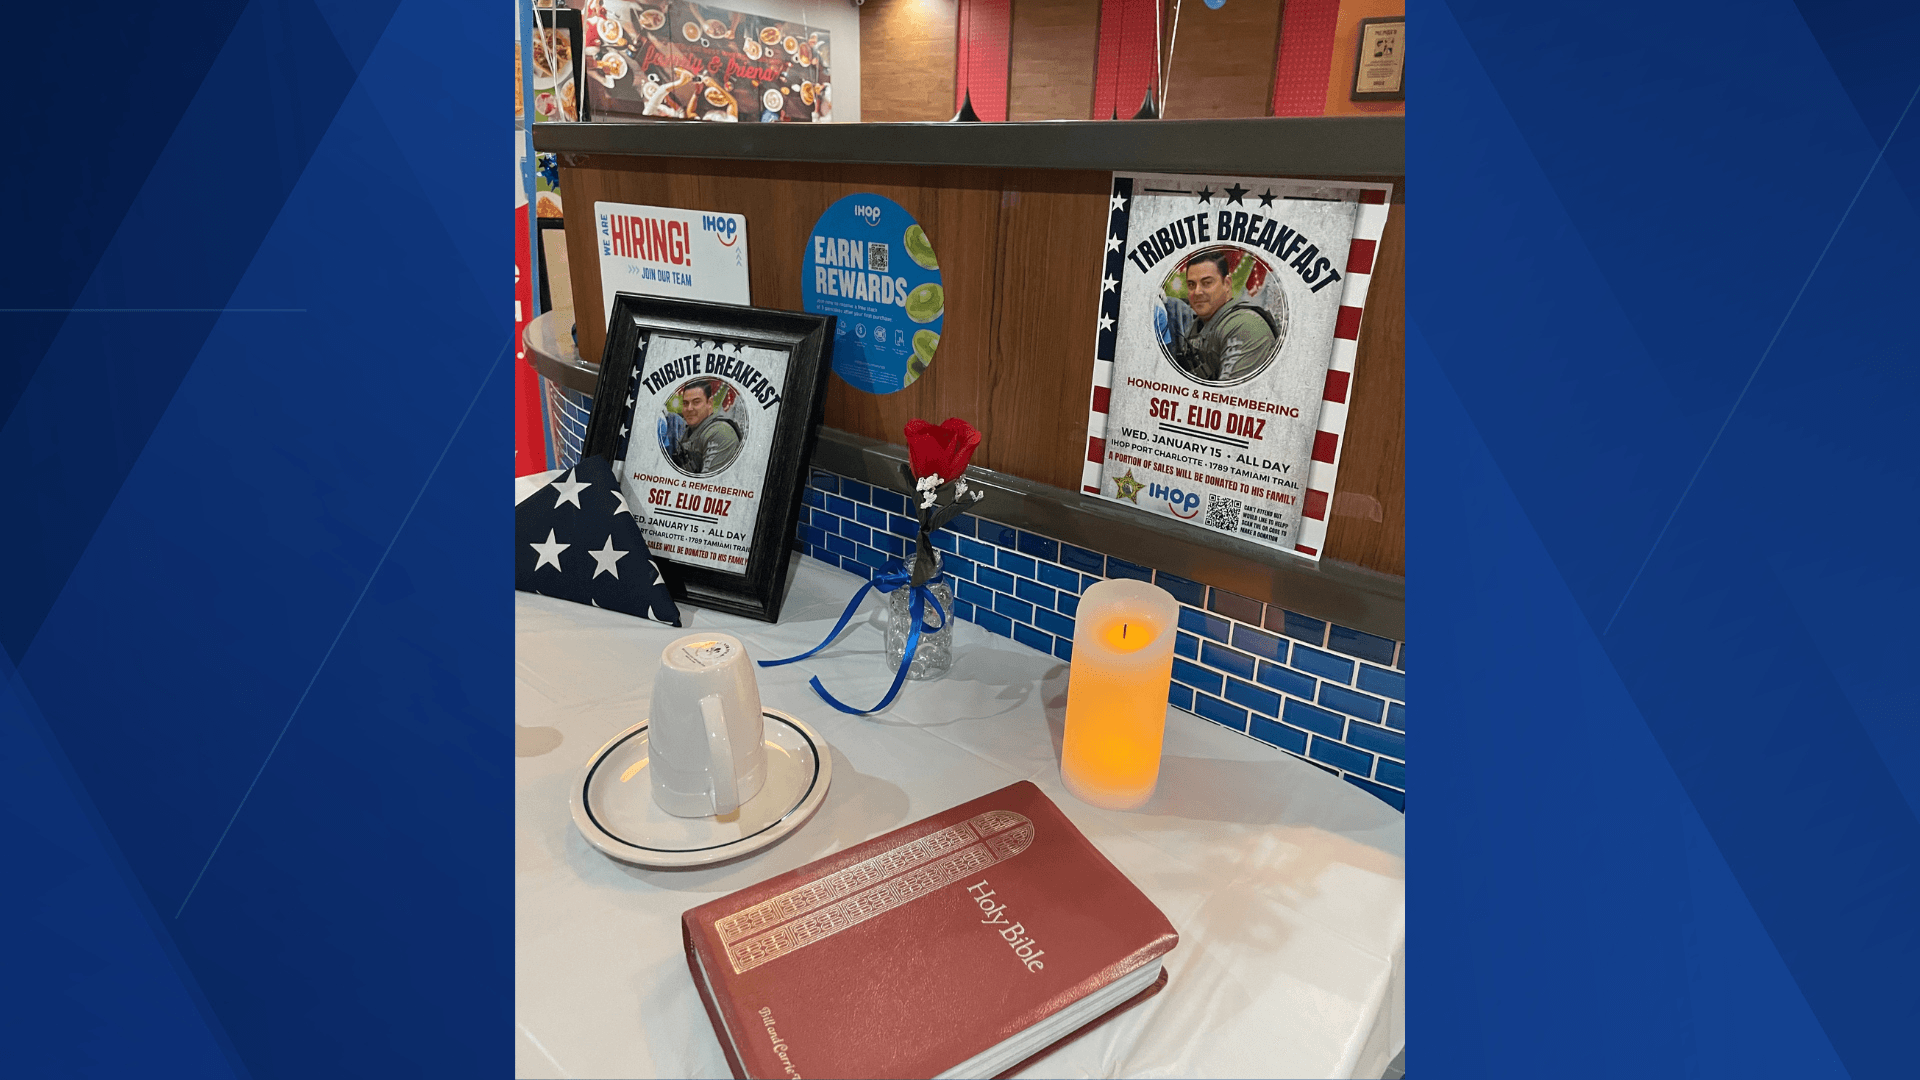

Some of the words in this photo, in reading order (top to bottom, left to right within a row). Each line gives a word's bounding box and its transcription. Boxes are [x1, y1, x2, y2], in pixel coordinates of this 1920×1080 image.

[708, 56, 723, 75] &
[600, 214, 609, 236] ARE
[602, 240, 611, 256] WE
[610, 214, 691, 267] HIRING!
[815, 235, 863, 270] EARN
[1128, 212, 1210, 274] TRIBUTE
[1217, 211, 1341, 293] BREAKFAST
[642, 267, 656, 281] JOIN
[658, 269, 670, 283] OUR
[672, 272, 692, 287] TEAM
[815, 266, 908, 307] REWARDS
[642, 354, 701, 395] TRIBUTE
[705, 353, 781, 410] BREAKFAST
[1127, 377, 1189, 397] HONORING
[1192, 390, 1199, 398] &
[1202, 391, 1299, 418] REMEMBERING
[1150, 398, 1181, 422] SGT.
[1187, 405, 1221, 431] ELIO
[1226, 413, 1266, 440] DIAZ
[1122, 427, 1149, 441] WED.
[1152, 434, 1208, 454] JANUARY
[1210, 447, 1222, 458] 15
[1236, 454, 1259, 467] ALL
[1262, 459, 1290, 473] DAY
[1108, 451, 1113, 460] A
[1114, 452, 1142, 467] PORTION
[1143, 459, 1152, 469] OF
[1153, 462, 1174, 475] SALES
[1176, 467, 1192, 480] WILL
[1194, 472, 1203, 483] BE
[1204, 475, 1238, 491] DONATED
[1240, 483, 1249, 494] TO
[1251, 486, 1265, 498] HIS
[1266, 490, 1296, 505] FAMILY
[1111, 439, 1130, 449] IHOP
[1131, 444, 1153, 454] PORT
[1154, 449, 1203, 466] CHARLOTTE
[1209, 462, 1228, 472] 1789
[1230, 467, 1270, 482] TAMIAMI
[1272, 477, 1299, 490] TRAIL
[633, 472, 680, 487] HONORING
[689, 481, 754, 499] REMEMBERING
[648, 488, 671, 507] SGT.
[676, 493, 701, 511] ELIO
[703, 497, 732, 517] DIAZ
[1244, 505, 1256, 513] CAN'T
[633, 514, 646, 524] ED.
[648, 518, 689, 531] JANUARY
[690, 525, 699, 533] 15
[708, 528, 724, 538] ALL
[727, 531, 746, 541] DAY
[1240, 527, 1252, 536] MAKE
[1257, 531, 1278, 542] DONATION
[1275, 521, 1289, 529] HELP?
[649, 530, 684, 541] CHARLOTTE
[704, 539, 731, 550] TAMIAMI
[664, 543, 675, 553] WILL
[677, 546, 684, 554] BE
[685, 548, 709, 558] DONATED
[710, 552, 716, 560] TO
[718, 553, 727, 562] HIS
[967, 879, 1009, 924] Holy
[999, 921, 1045, 973] Bible
[758, 1006, 776, 1027] Bill
[767, 1026, 784, 1045] and
[773, 1044, 795, 1074] Carrie
